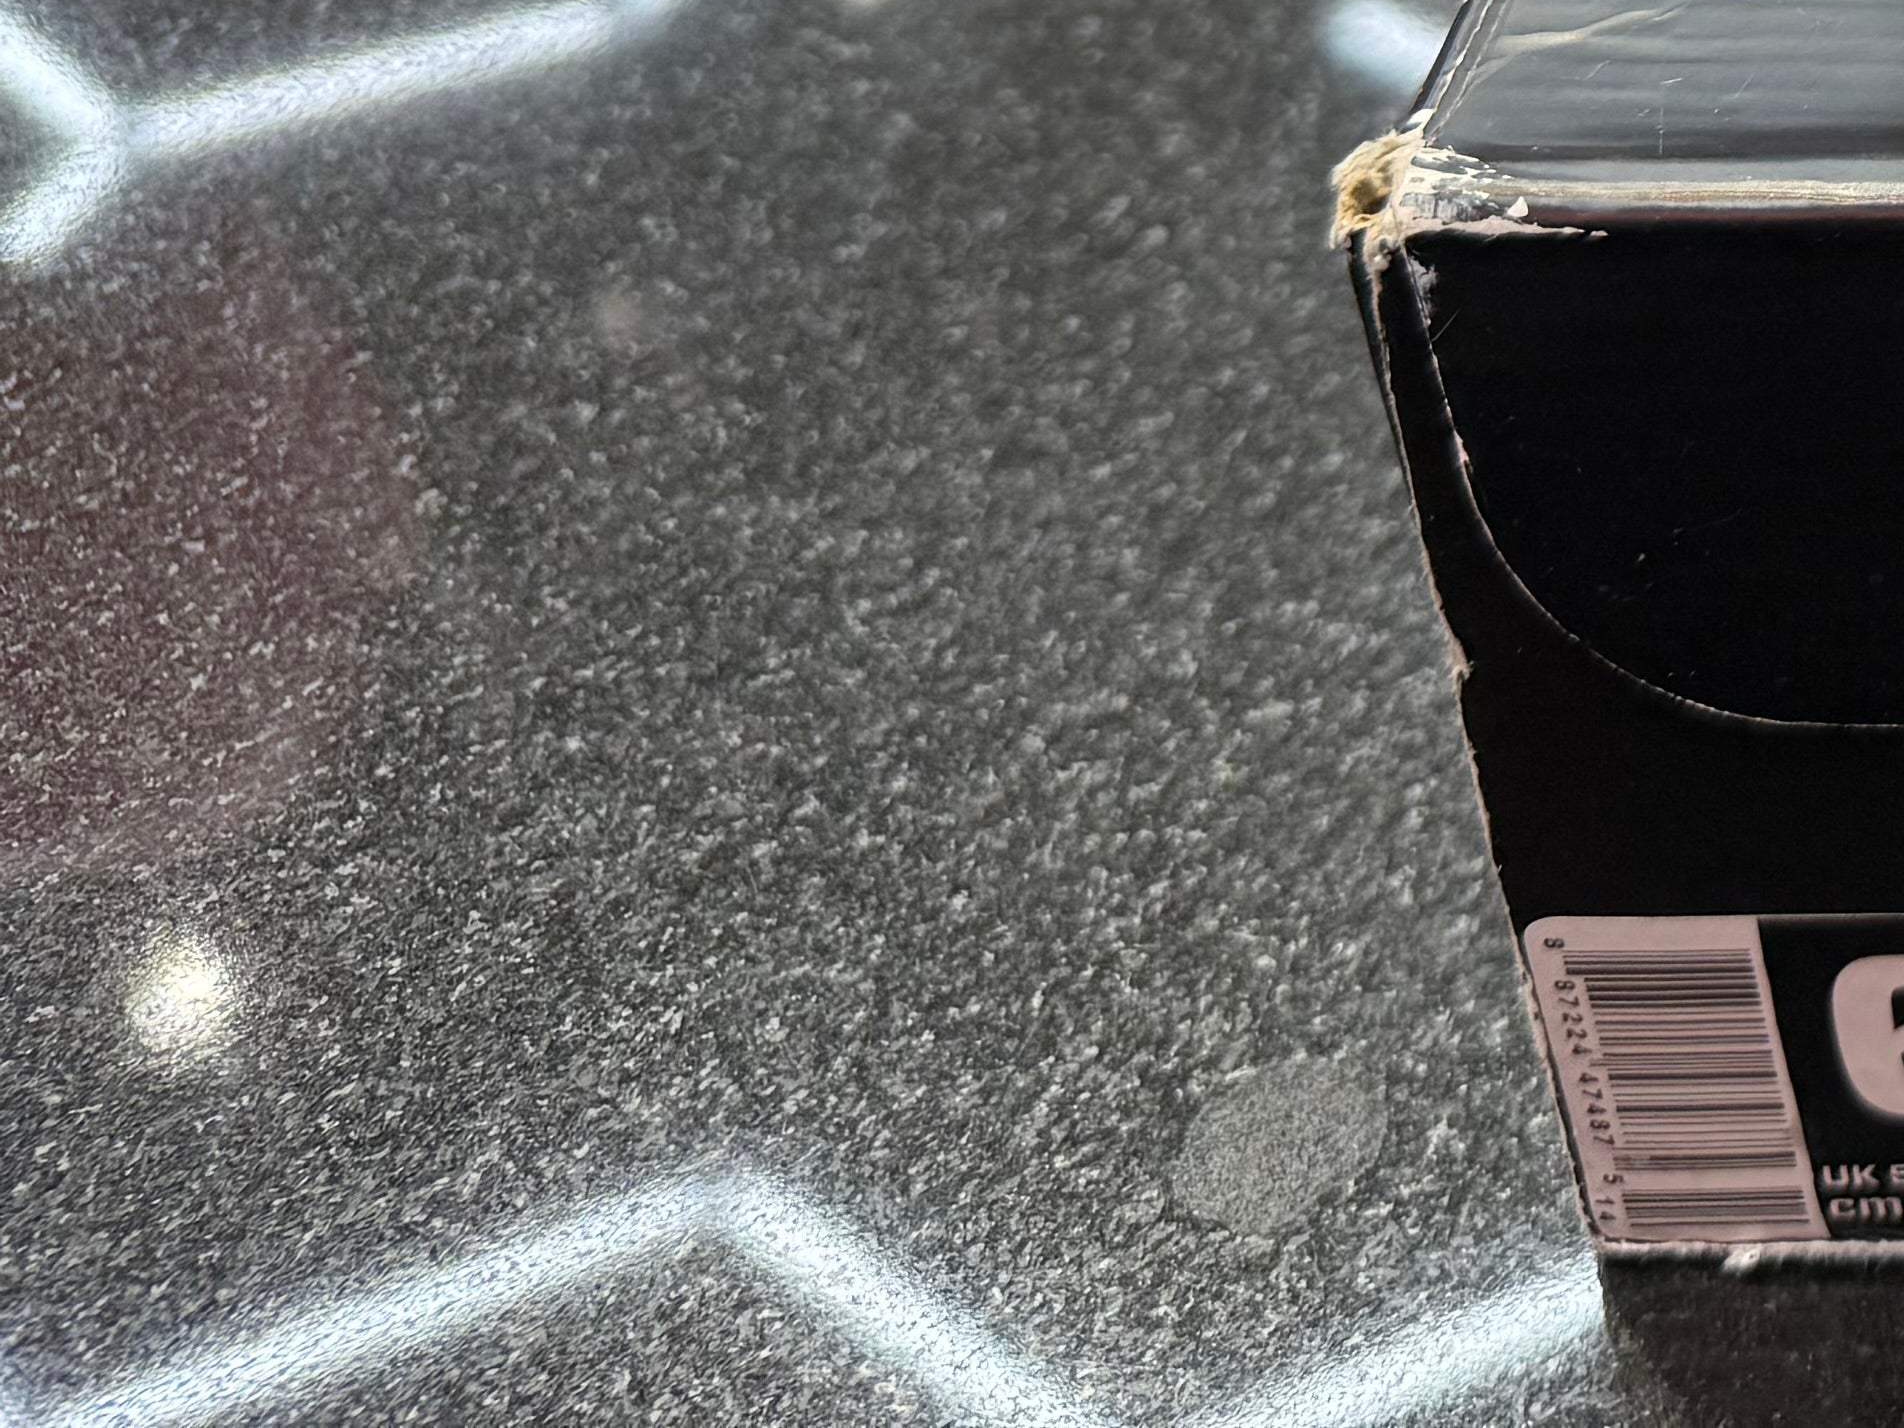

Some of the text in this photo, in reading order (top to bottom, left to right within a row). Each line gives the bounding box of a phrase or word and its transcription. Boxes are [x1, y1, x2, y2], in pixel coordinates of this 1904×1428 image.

[1543, 937, 1565, 950] 8
[1553, 978, 1590, 1056] 87224
[1602, 1172, 1624, 1185] 5
[1822, 1164, 1879, 1188] UK
